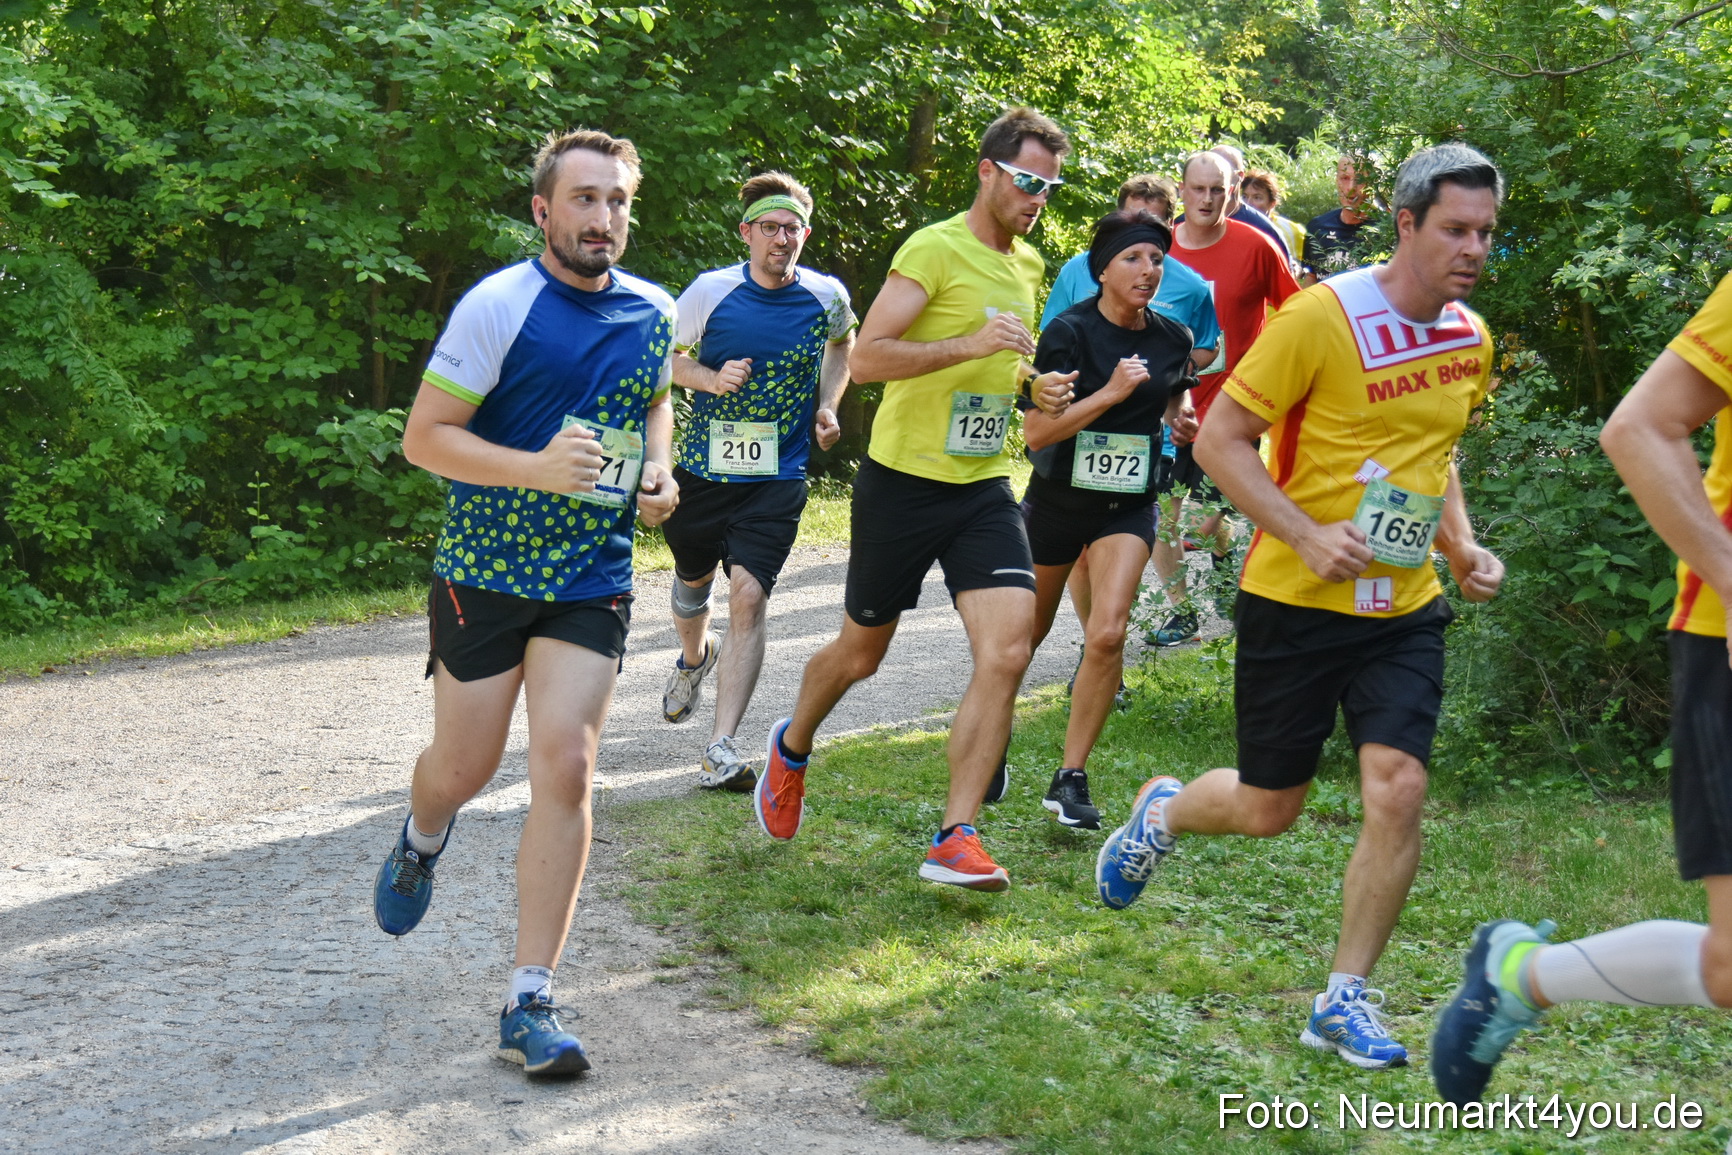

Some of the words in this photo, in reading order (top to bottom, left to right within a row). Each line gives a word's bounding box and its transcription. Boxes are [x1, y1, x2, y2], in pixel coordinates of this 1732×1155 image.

[1366, 369, 1432, 404] MAX
[1436, 356, 1482, 386] BÖGL
[958, 415, 1004, 439] 1293
[722, 440, 761, 460] 210
[600, 455, 625, 485] 71
[1084, 452, 1140, 476] 1972
[1370, 511, 1431, 548] 1658
